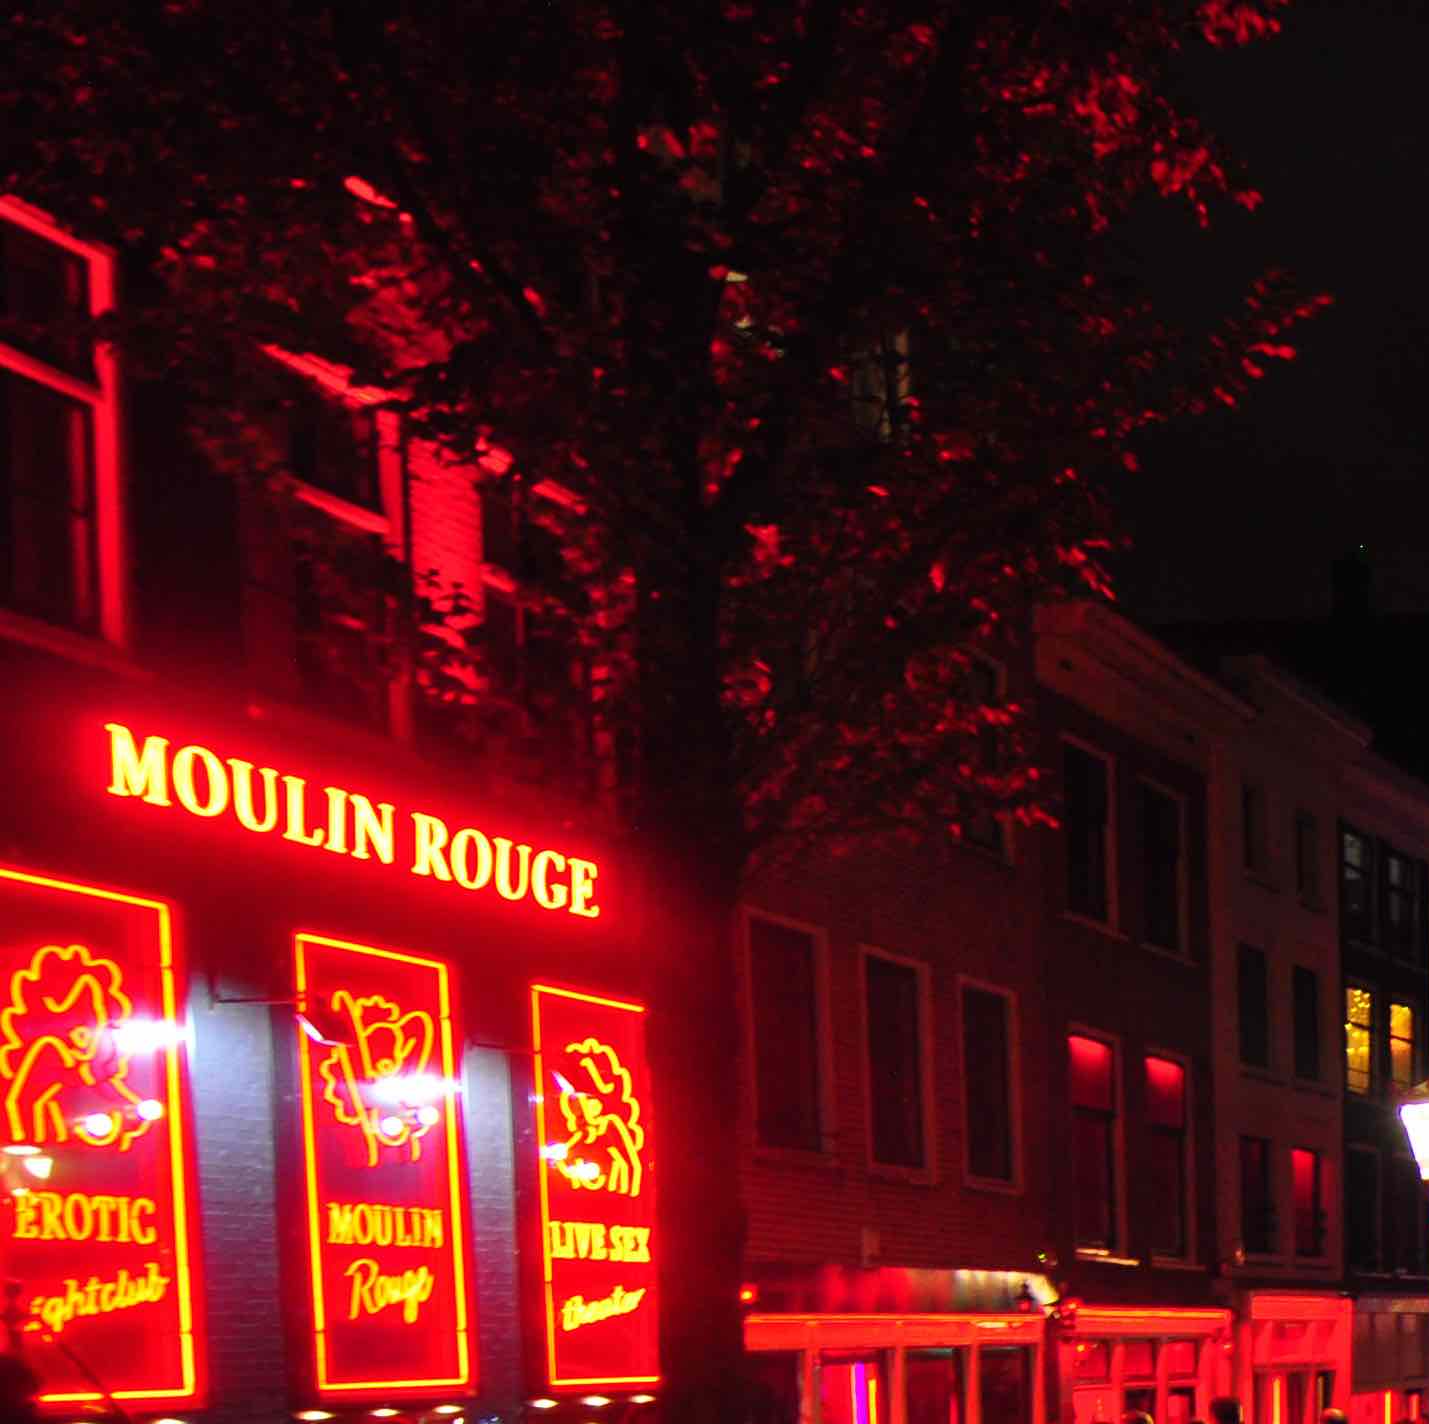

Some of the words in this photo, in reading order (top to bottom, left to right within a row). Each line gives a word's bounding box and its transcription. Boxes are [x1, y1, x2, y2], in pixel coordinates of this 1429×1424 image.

[104, 722, 395, 866] MOULIN
[411, 810, 602, 919] ROUGE
[12, 1188, 157, 1244] EROTIC
[326, 1201, 444, 1248] MOULIN
[549, 1221, 608, 1260] LIVE
[609, 1225, 651, 1263] SEX
